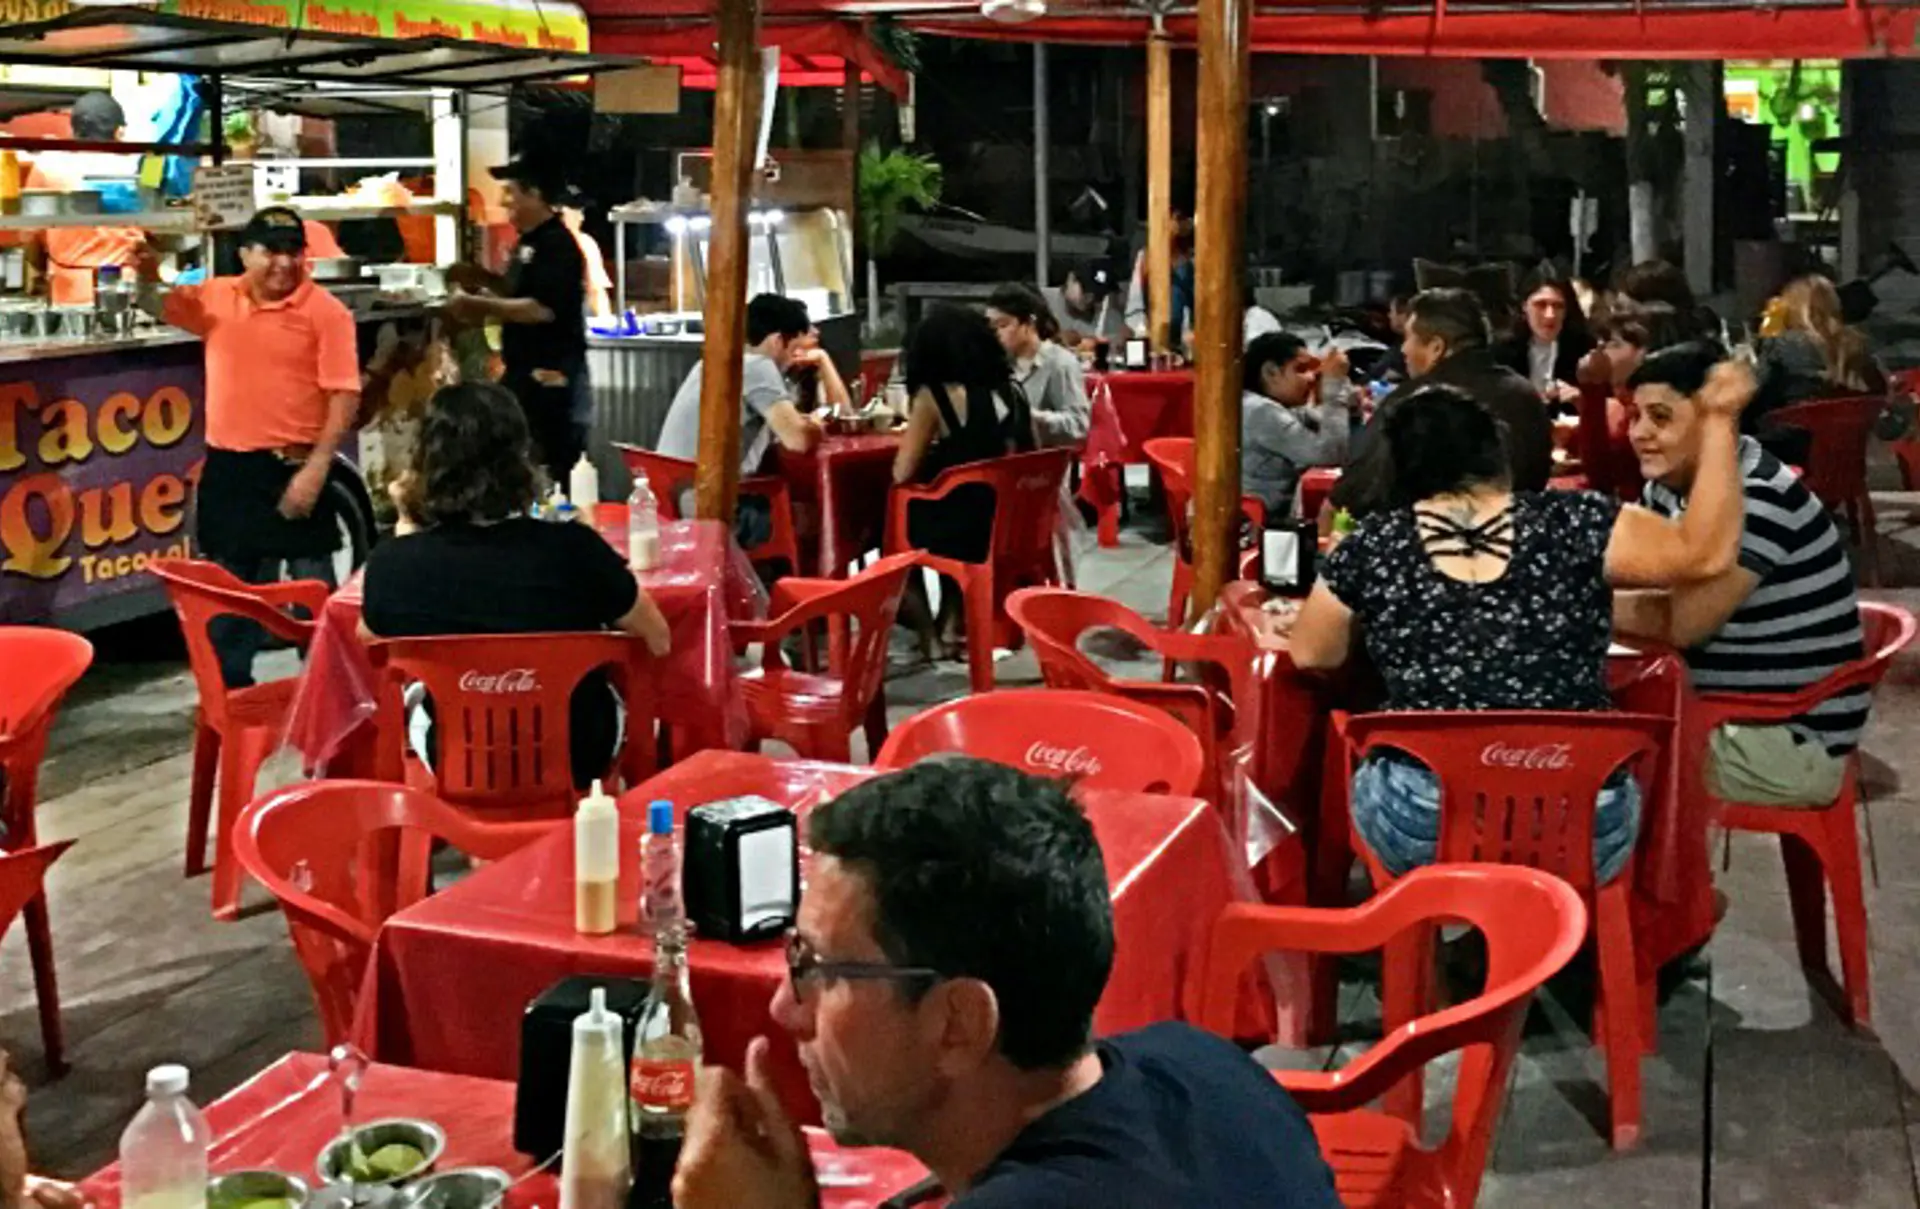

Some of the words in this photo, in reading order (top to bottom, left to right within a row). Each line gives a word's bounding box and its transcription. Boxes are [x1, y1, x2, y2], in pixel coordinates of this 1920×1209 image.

[0, 380, 192, 471] Taco
[0, 456, 206, 579] Que
[79, 549, 159, 585] Taco
